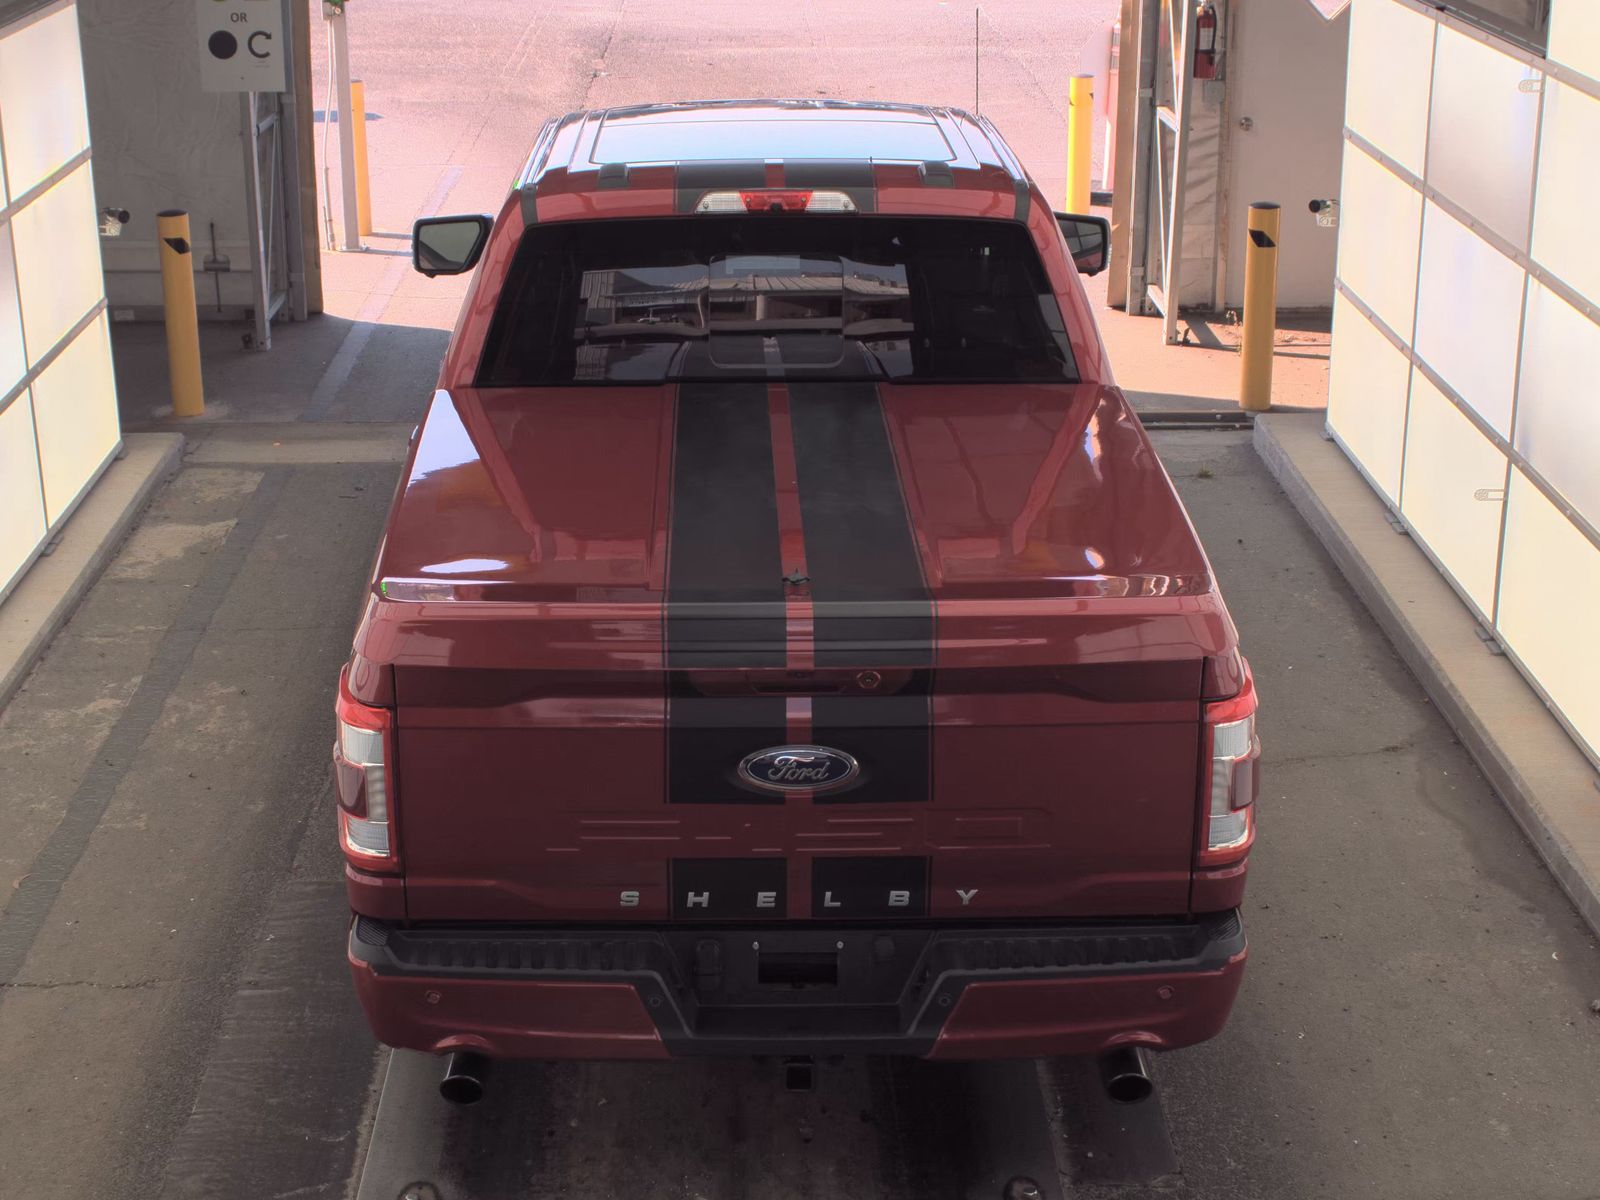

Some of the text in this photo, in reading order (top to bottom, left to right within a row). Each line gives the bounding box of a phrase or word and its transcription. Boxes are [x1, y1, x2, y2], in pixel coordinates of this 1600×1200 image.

[230, 12, 248, 23] OR
[767, 755, 831, 780] Ford
[619, 889, 979, 908] SHELBY
